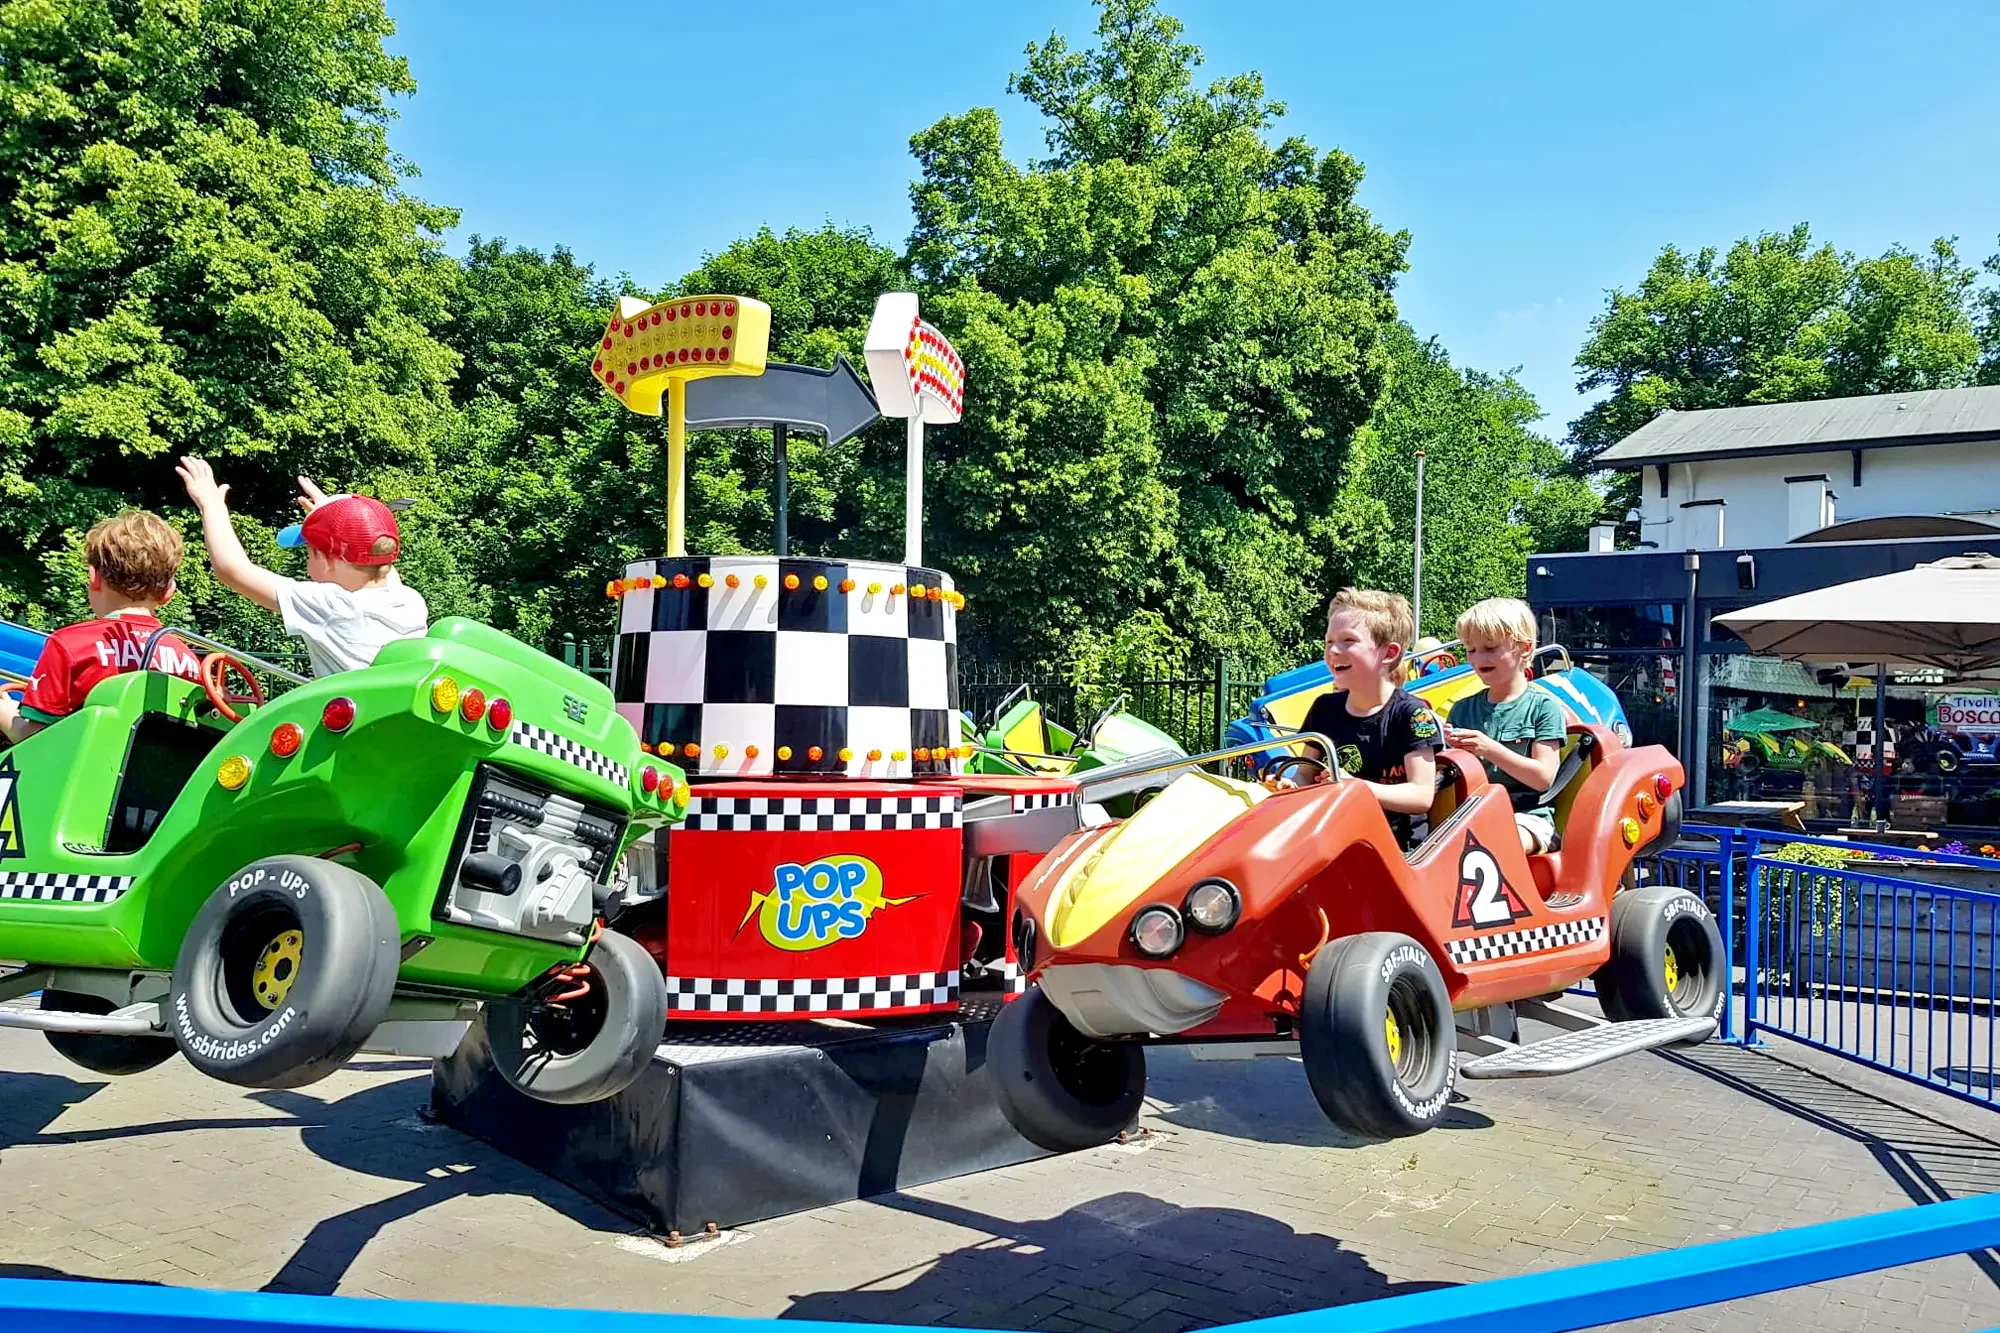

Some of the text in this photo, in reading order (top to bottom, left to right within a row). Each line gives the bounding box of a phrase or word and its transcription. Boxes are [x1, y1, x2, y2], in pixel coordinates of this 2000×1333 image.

[229, 869, 265, 897] POP
[280, 870, 310, 899] UPS
[775, 862, 867, 901] POP
[1462, 850, 1512, 924] 2
[777, 900, 867, 940] UPS
[1663, 898, 1708, 921] SBF-ITALY
[1381, 945, 1427, 983] SBF-ITALY
[176, 992, 296, 1060] www.sbfrides.com
[1392, 1049, 1457, 1119] www.sbfrides.com
